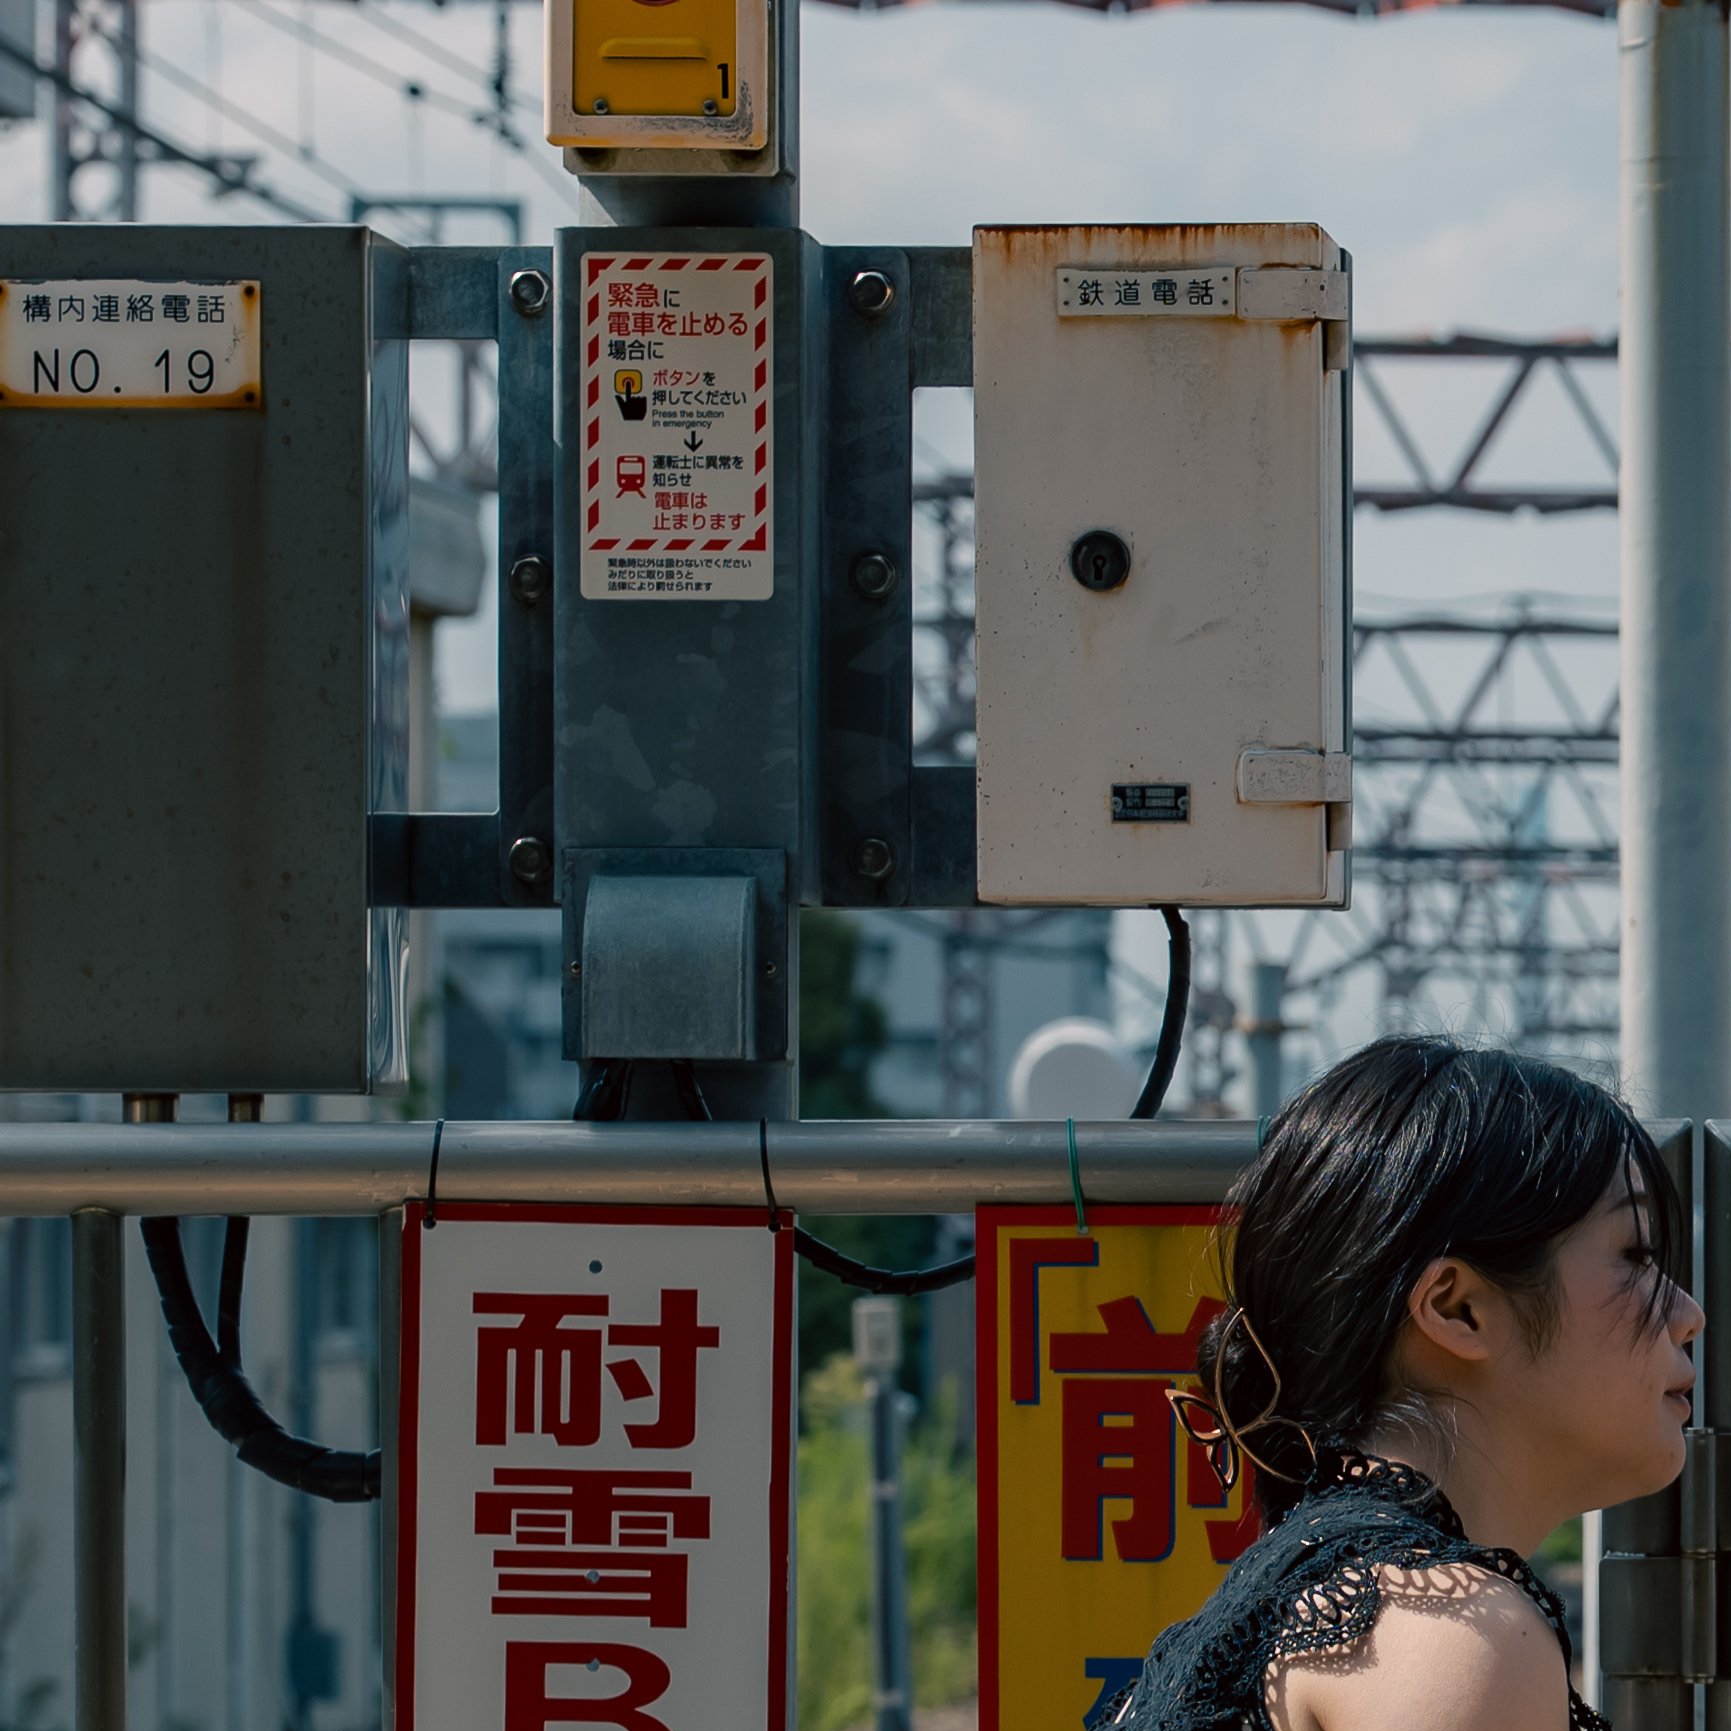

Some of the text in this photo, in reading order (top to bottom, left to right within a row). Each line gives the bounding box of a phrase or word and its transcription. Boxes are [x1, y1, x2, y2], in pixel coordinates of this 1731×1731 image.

[716, 63, 730, 99] 1
[607, 282, 680, 308] 緊急に
[1078, 279, 1216, 307] 鉄道電話
[22, 294, 226, 324] 構内連絡電話
[607, 311, 748, 337] 電車を止める
[607, 339, 664, 361] 場合に
[33, 348, 215, 394] NO. 19
[653, 369, 716, 386] ボタンを
[652, 390, 746, 405] 押してください
[652, 410, 724, 418] Press the button
[663, 420, 712, 429] emergency
[653, 455, 744, 470] 運転士に異常を
[653, 473, 692, 487] 知らせ
[654, 492, 708, 510] 電車は
[653, 512, 745, 530] 止まります
